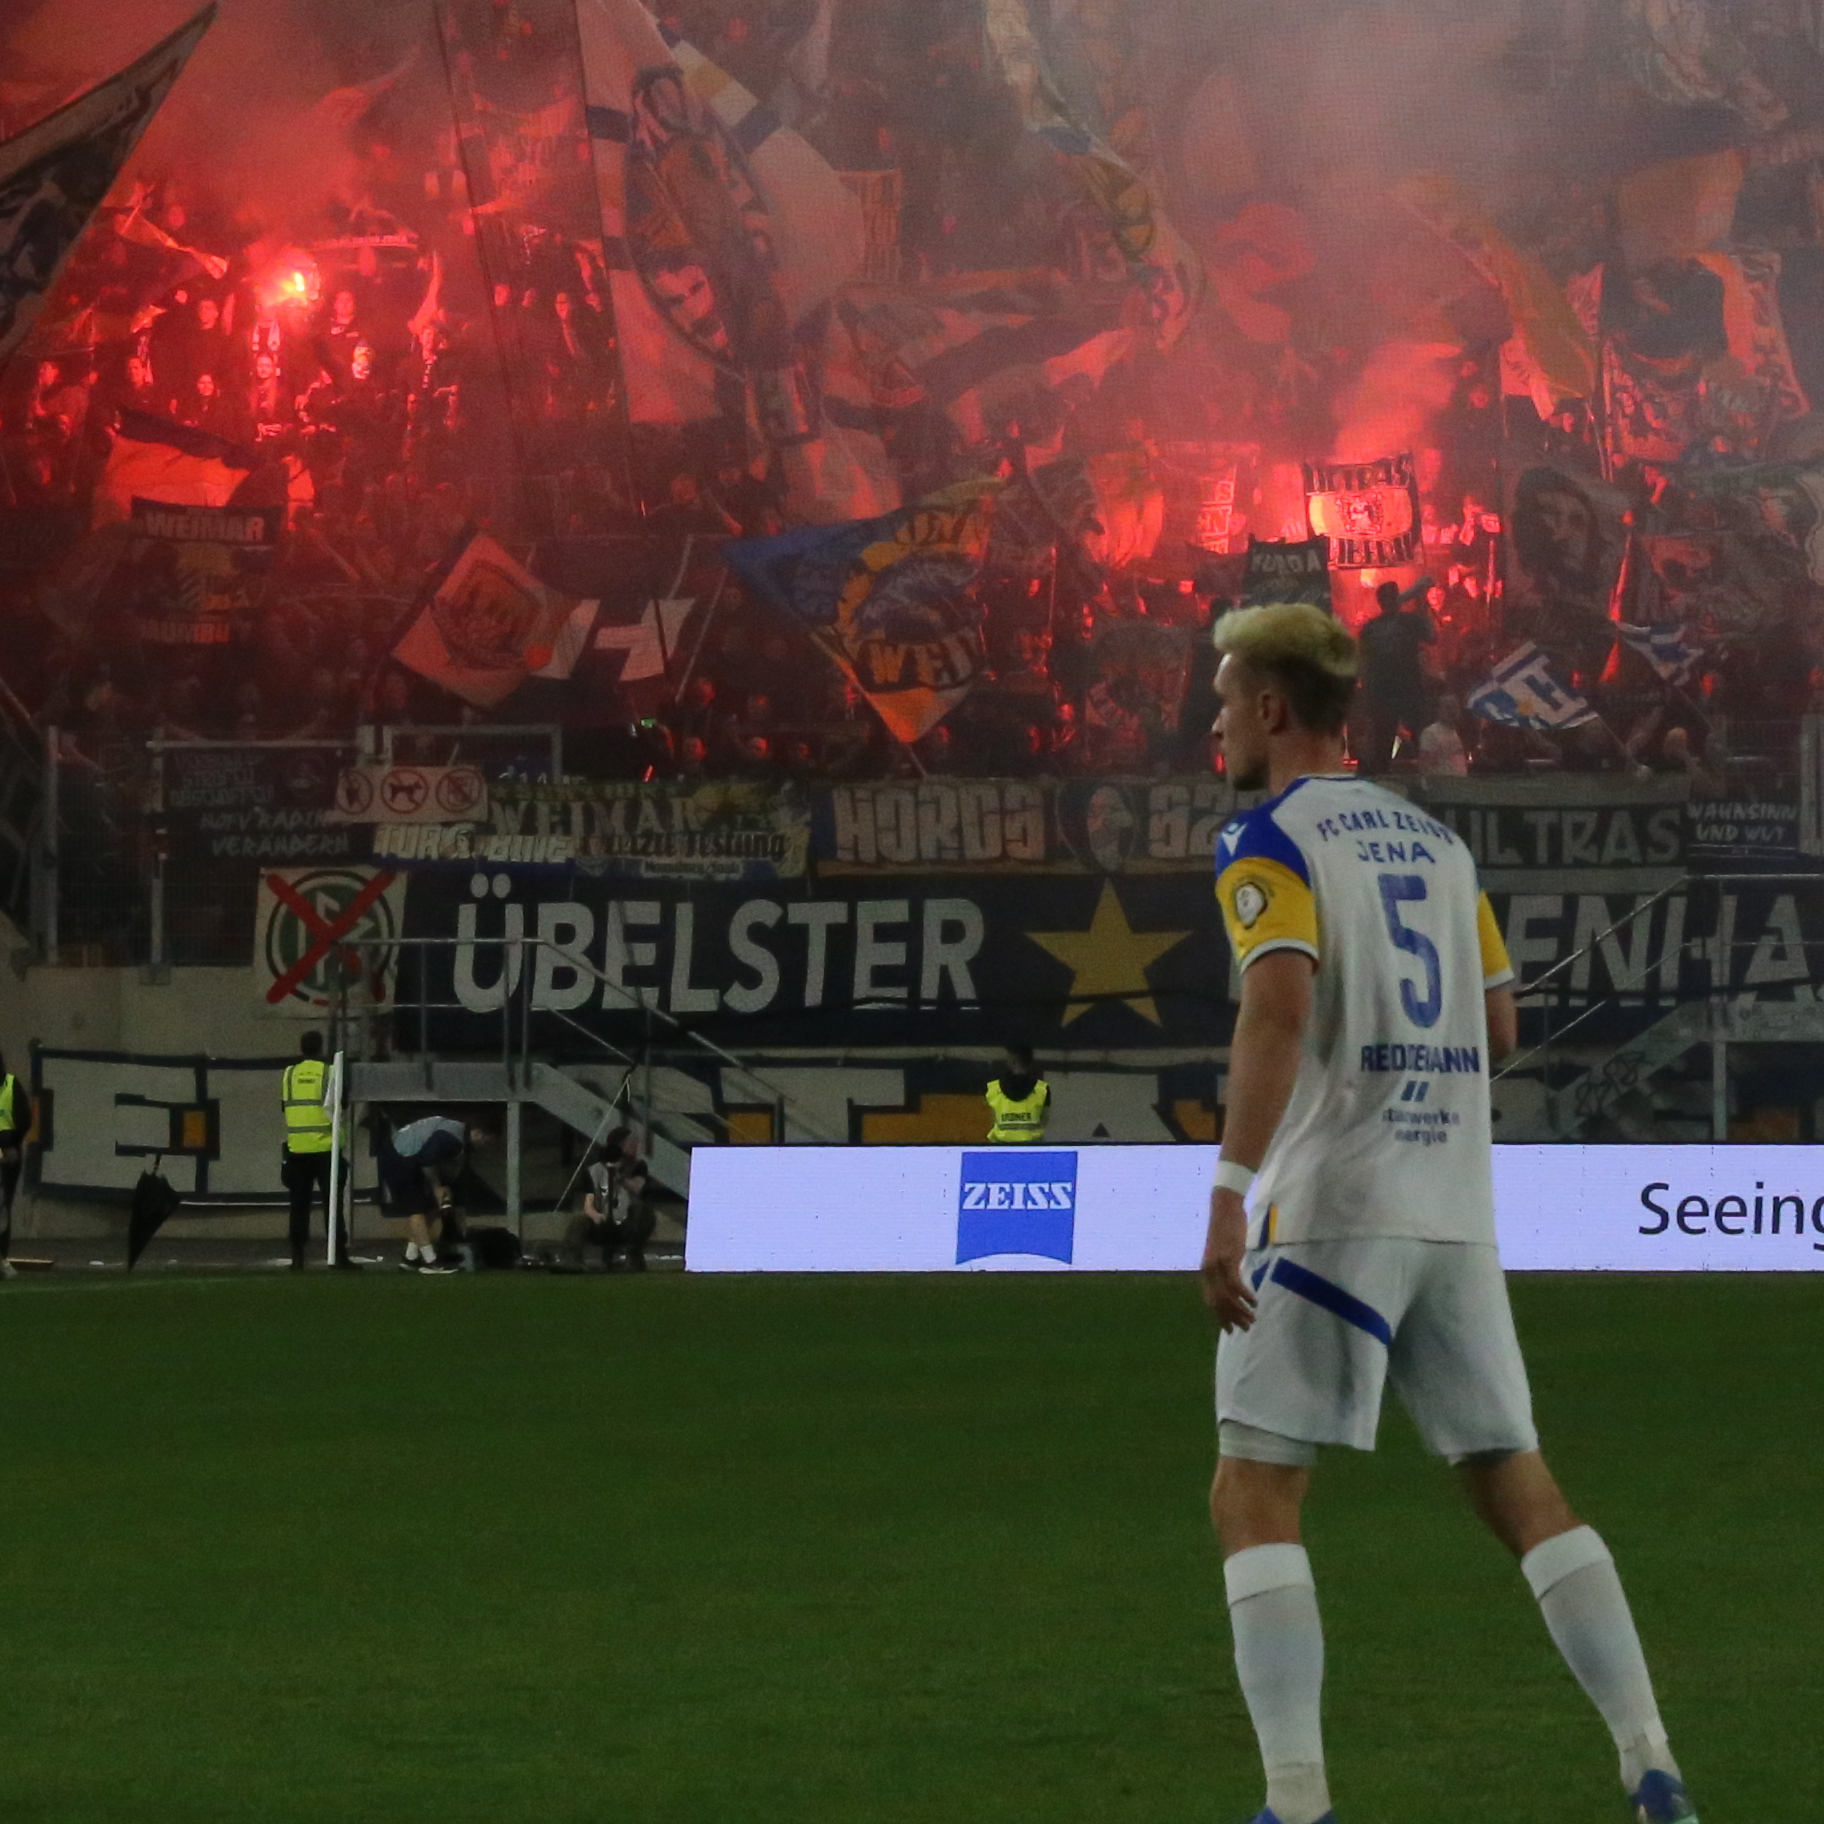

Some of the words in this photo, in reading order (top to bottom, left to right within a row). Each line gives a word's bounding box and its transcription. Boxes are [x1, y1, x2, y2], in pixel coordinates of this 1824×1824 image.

[1338, 810, 1389, 833] CARL
[1357, 841, 1436, 864] JENA
[453, 873, 985, 1014] ÜBELSTER
[1378, 873, 1442, 1028] 5
[962, 1180, 1077, 1211] ZEISS
